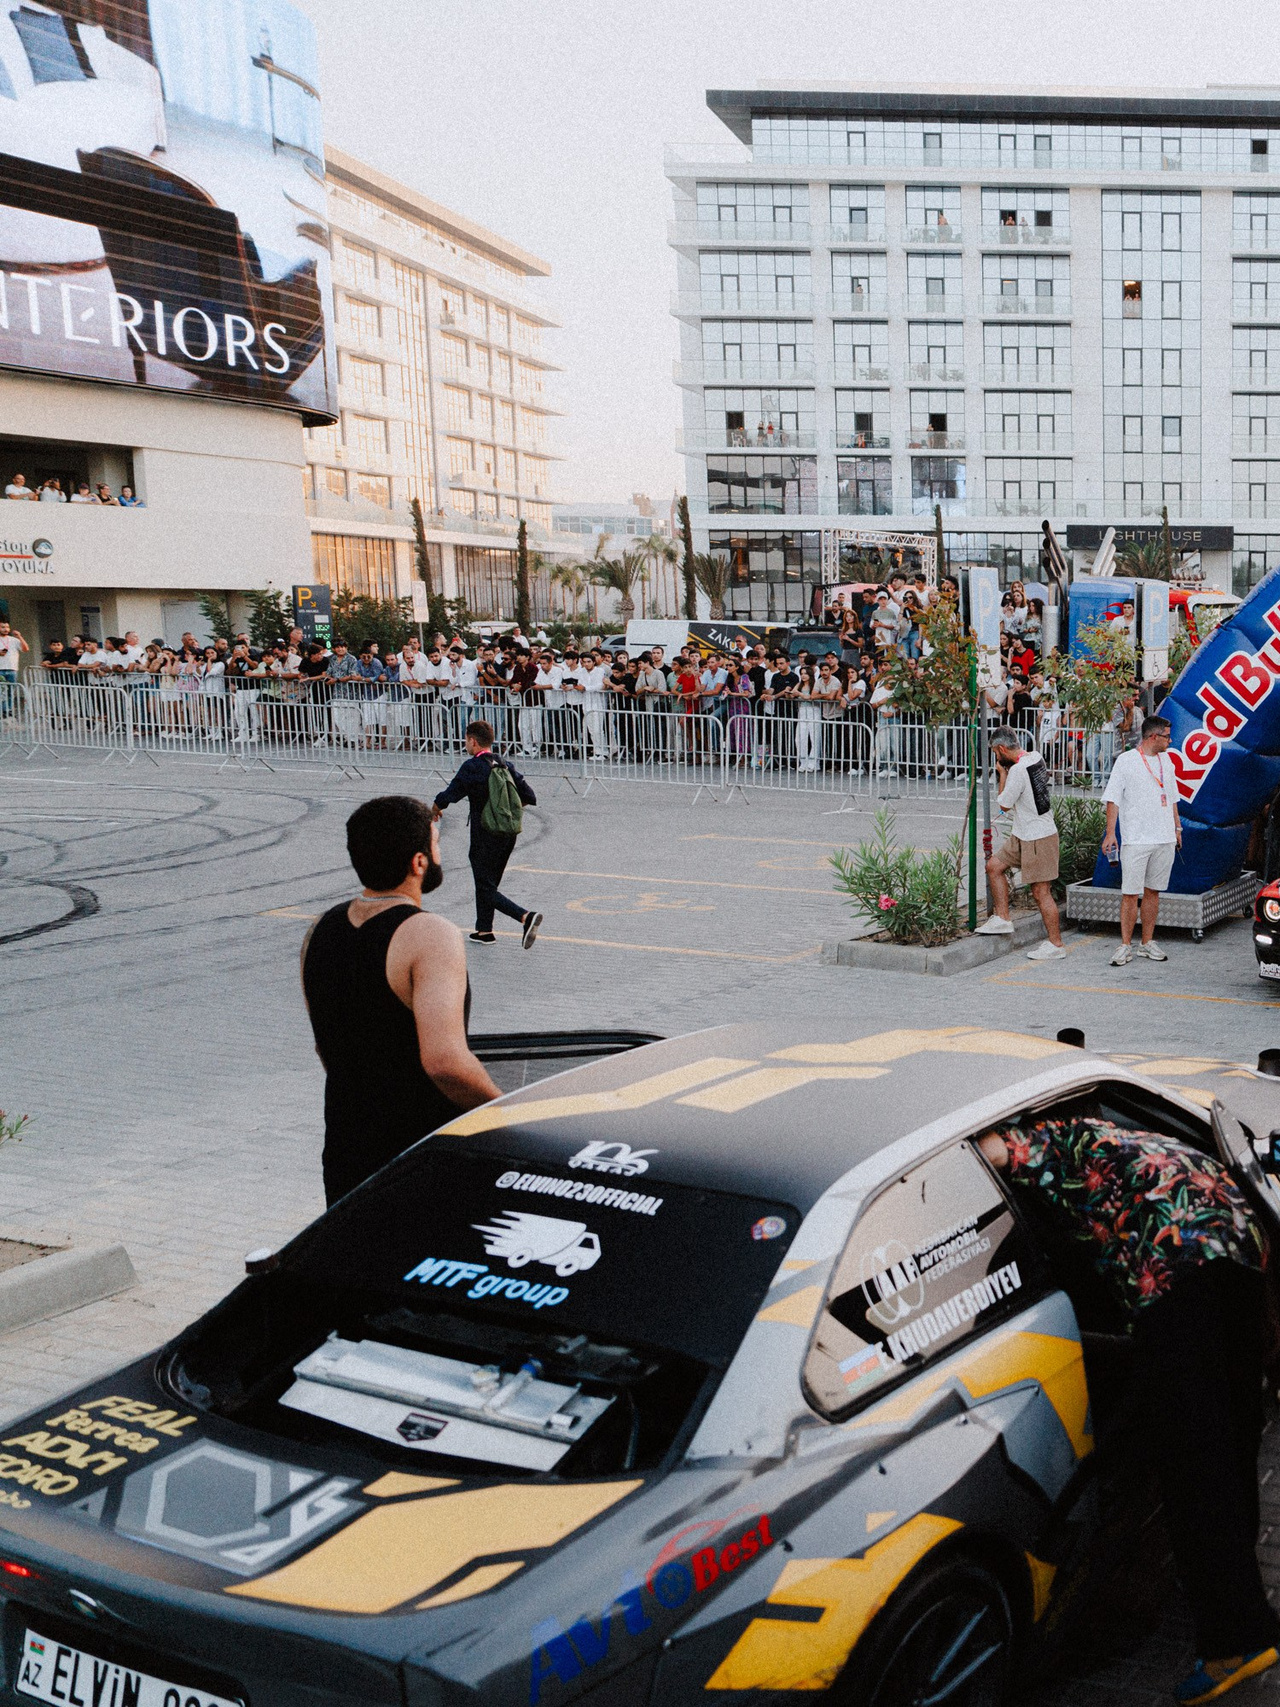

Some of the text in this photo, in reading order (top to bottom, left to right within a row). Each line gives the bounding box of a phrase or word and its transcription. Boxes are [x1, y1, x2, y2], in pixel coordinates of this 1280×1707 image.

[1100, 530, 1202, 542] LGHTHUSE
[0, 559, 55, 574] OYUMA
[297, 587, 312, 607] P
[1167, 683, 1248, 804] Red
[403, 1257, 569, 1309] MTF group
[45, 1409, 159, 1453] Ferrea
[79, 1395, 198, 1437] FEAL
[21, 1660, 43, 1689] AZ
